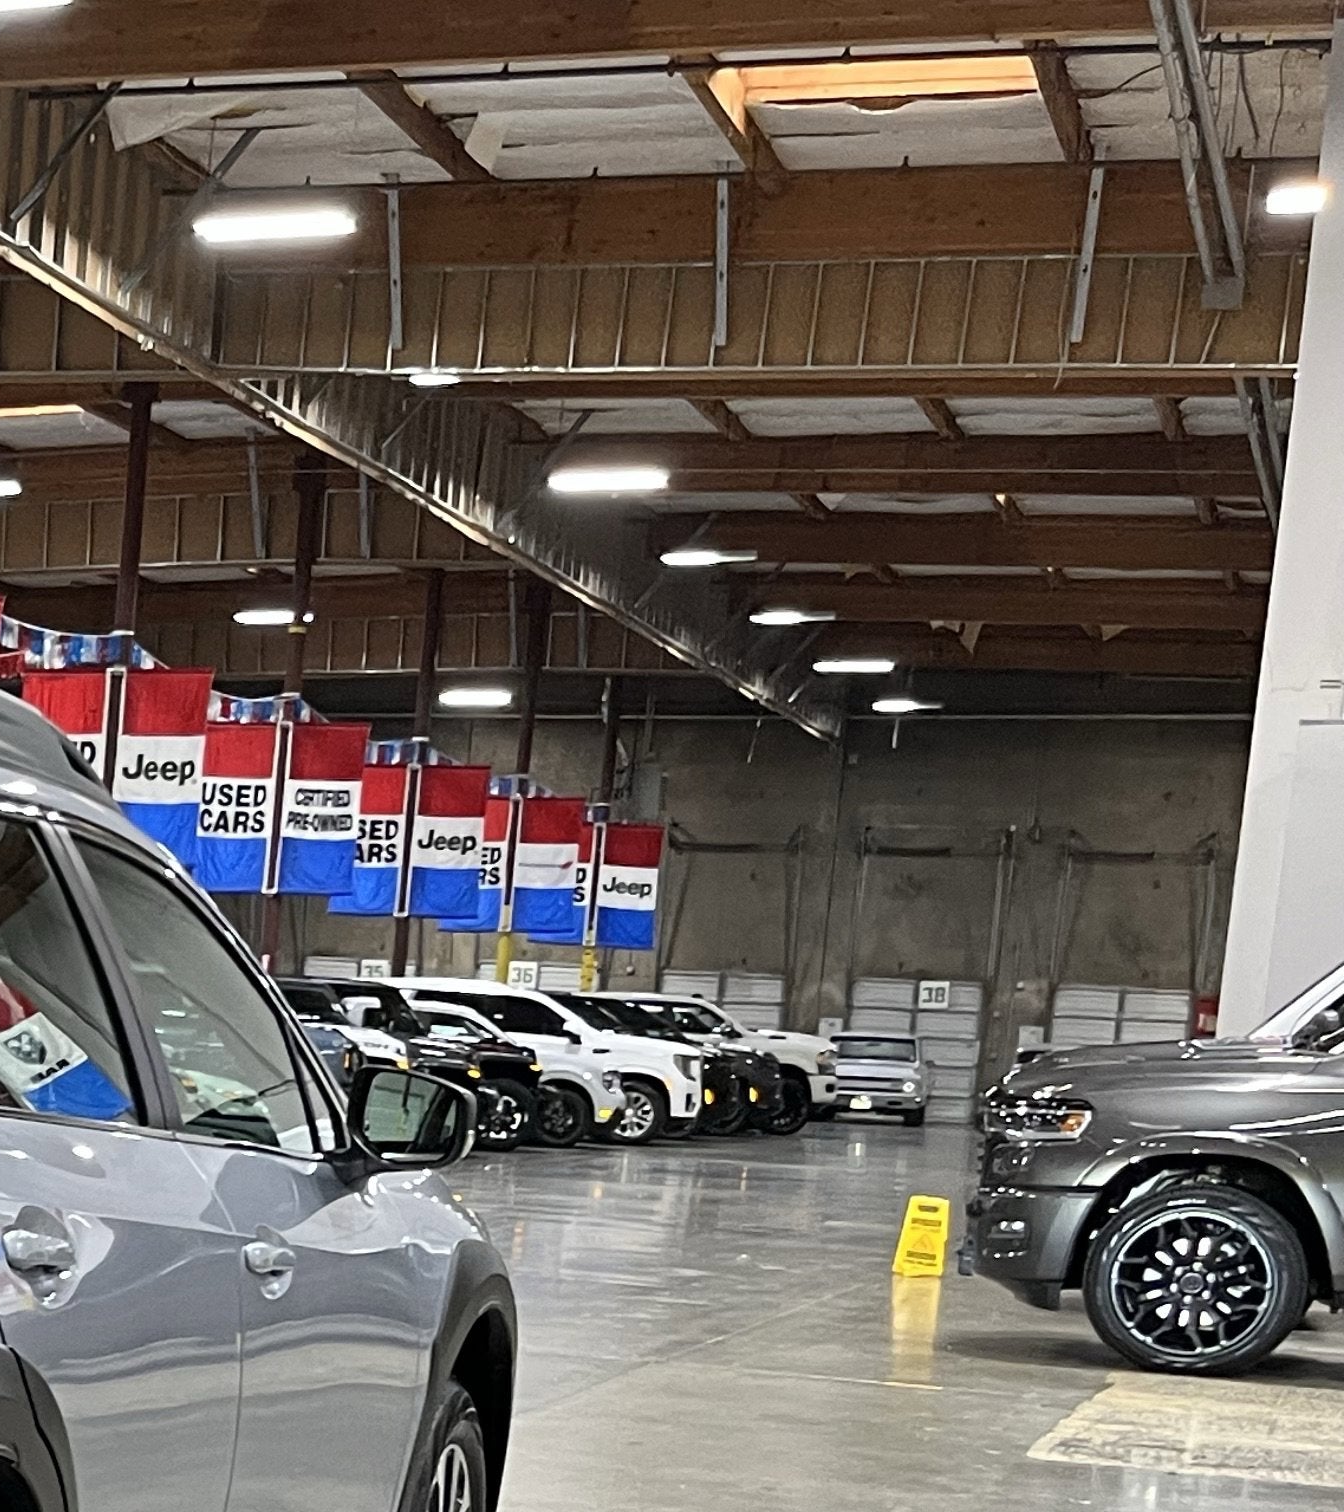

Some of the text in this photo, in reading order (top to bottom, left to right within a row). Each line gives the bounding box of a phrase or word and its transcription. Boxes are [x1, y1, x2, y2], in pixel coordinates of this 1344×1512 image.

[122, 753, 195, 786] Jeep
[201, 782, 267, 808] USED
[199, 810, 265, 834] CARS
[417, 829, 477, 855] Jeep
[603, 877, 652, 898] Jeep
[513, 967, 533, 984] 36
